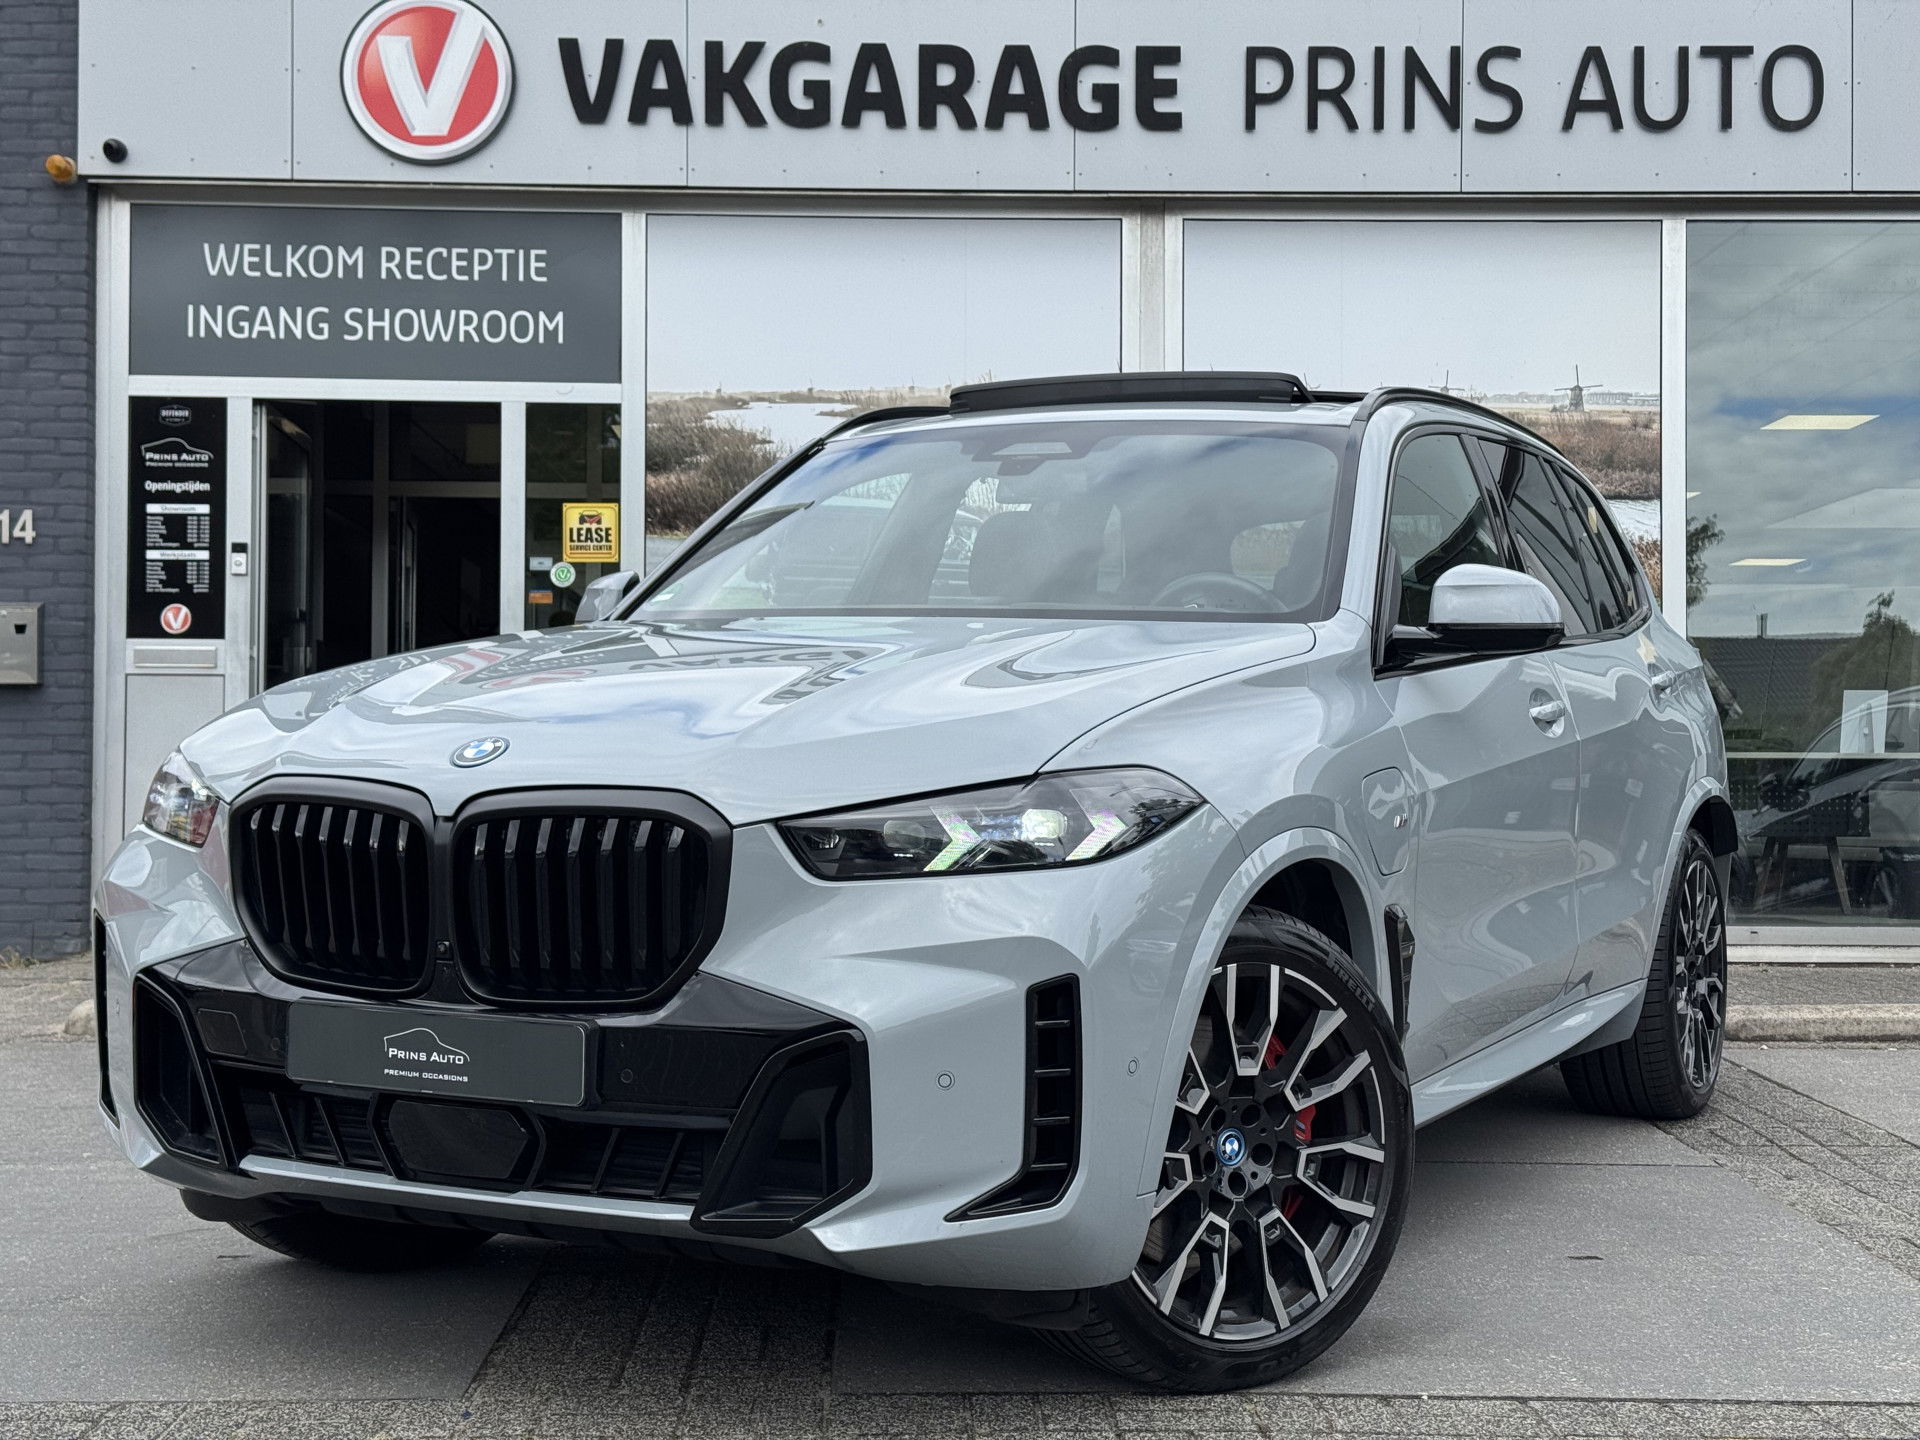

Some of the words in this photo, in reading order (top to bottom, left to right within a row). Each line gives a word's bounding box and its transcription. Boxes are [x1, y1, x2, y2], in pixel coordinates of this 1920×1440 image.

[557, 38, 1183, 132] VAKGARAGE
[1244, 45, 1525, 133] PRINS
[1561, 45, 1825, 133] AUTO
[203, 242, 364, 280] WELKOM
[380, 246, 548, 283] RECEPTIE
[186, 303, 330, 341] INGANG
[344, 307, 565, 345] SHOWROOM
[145, 452, 179, 461] PRINS
[181, 452, 209, 462] AUTO
[144, 480, 211, 494] Openingstijden
[0, 508, 37, 545] 14
[569, 527, 613, 543] LEASE
[384, 1068, 420, 1078] PREMIUM
[422, 1072, 469, 1082] OCCASIONS
